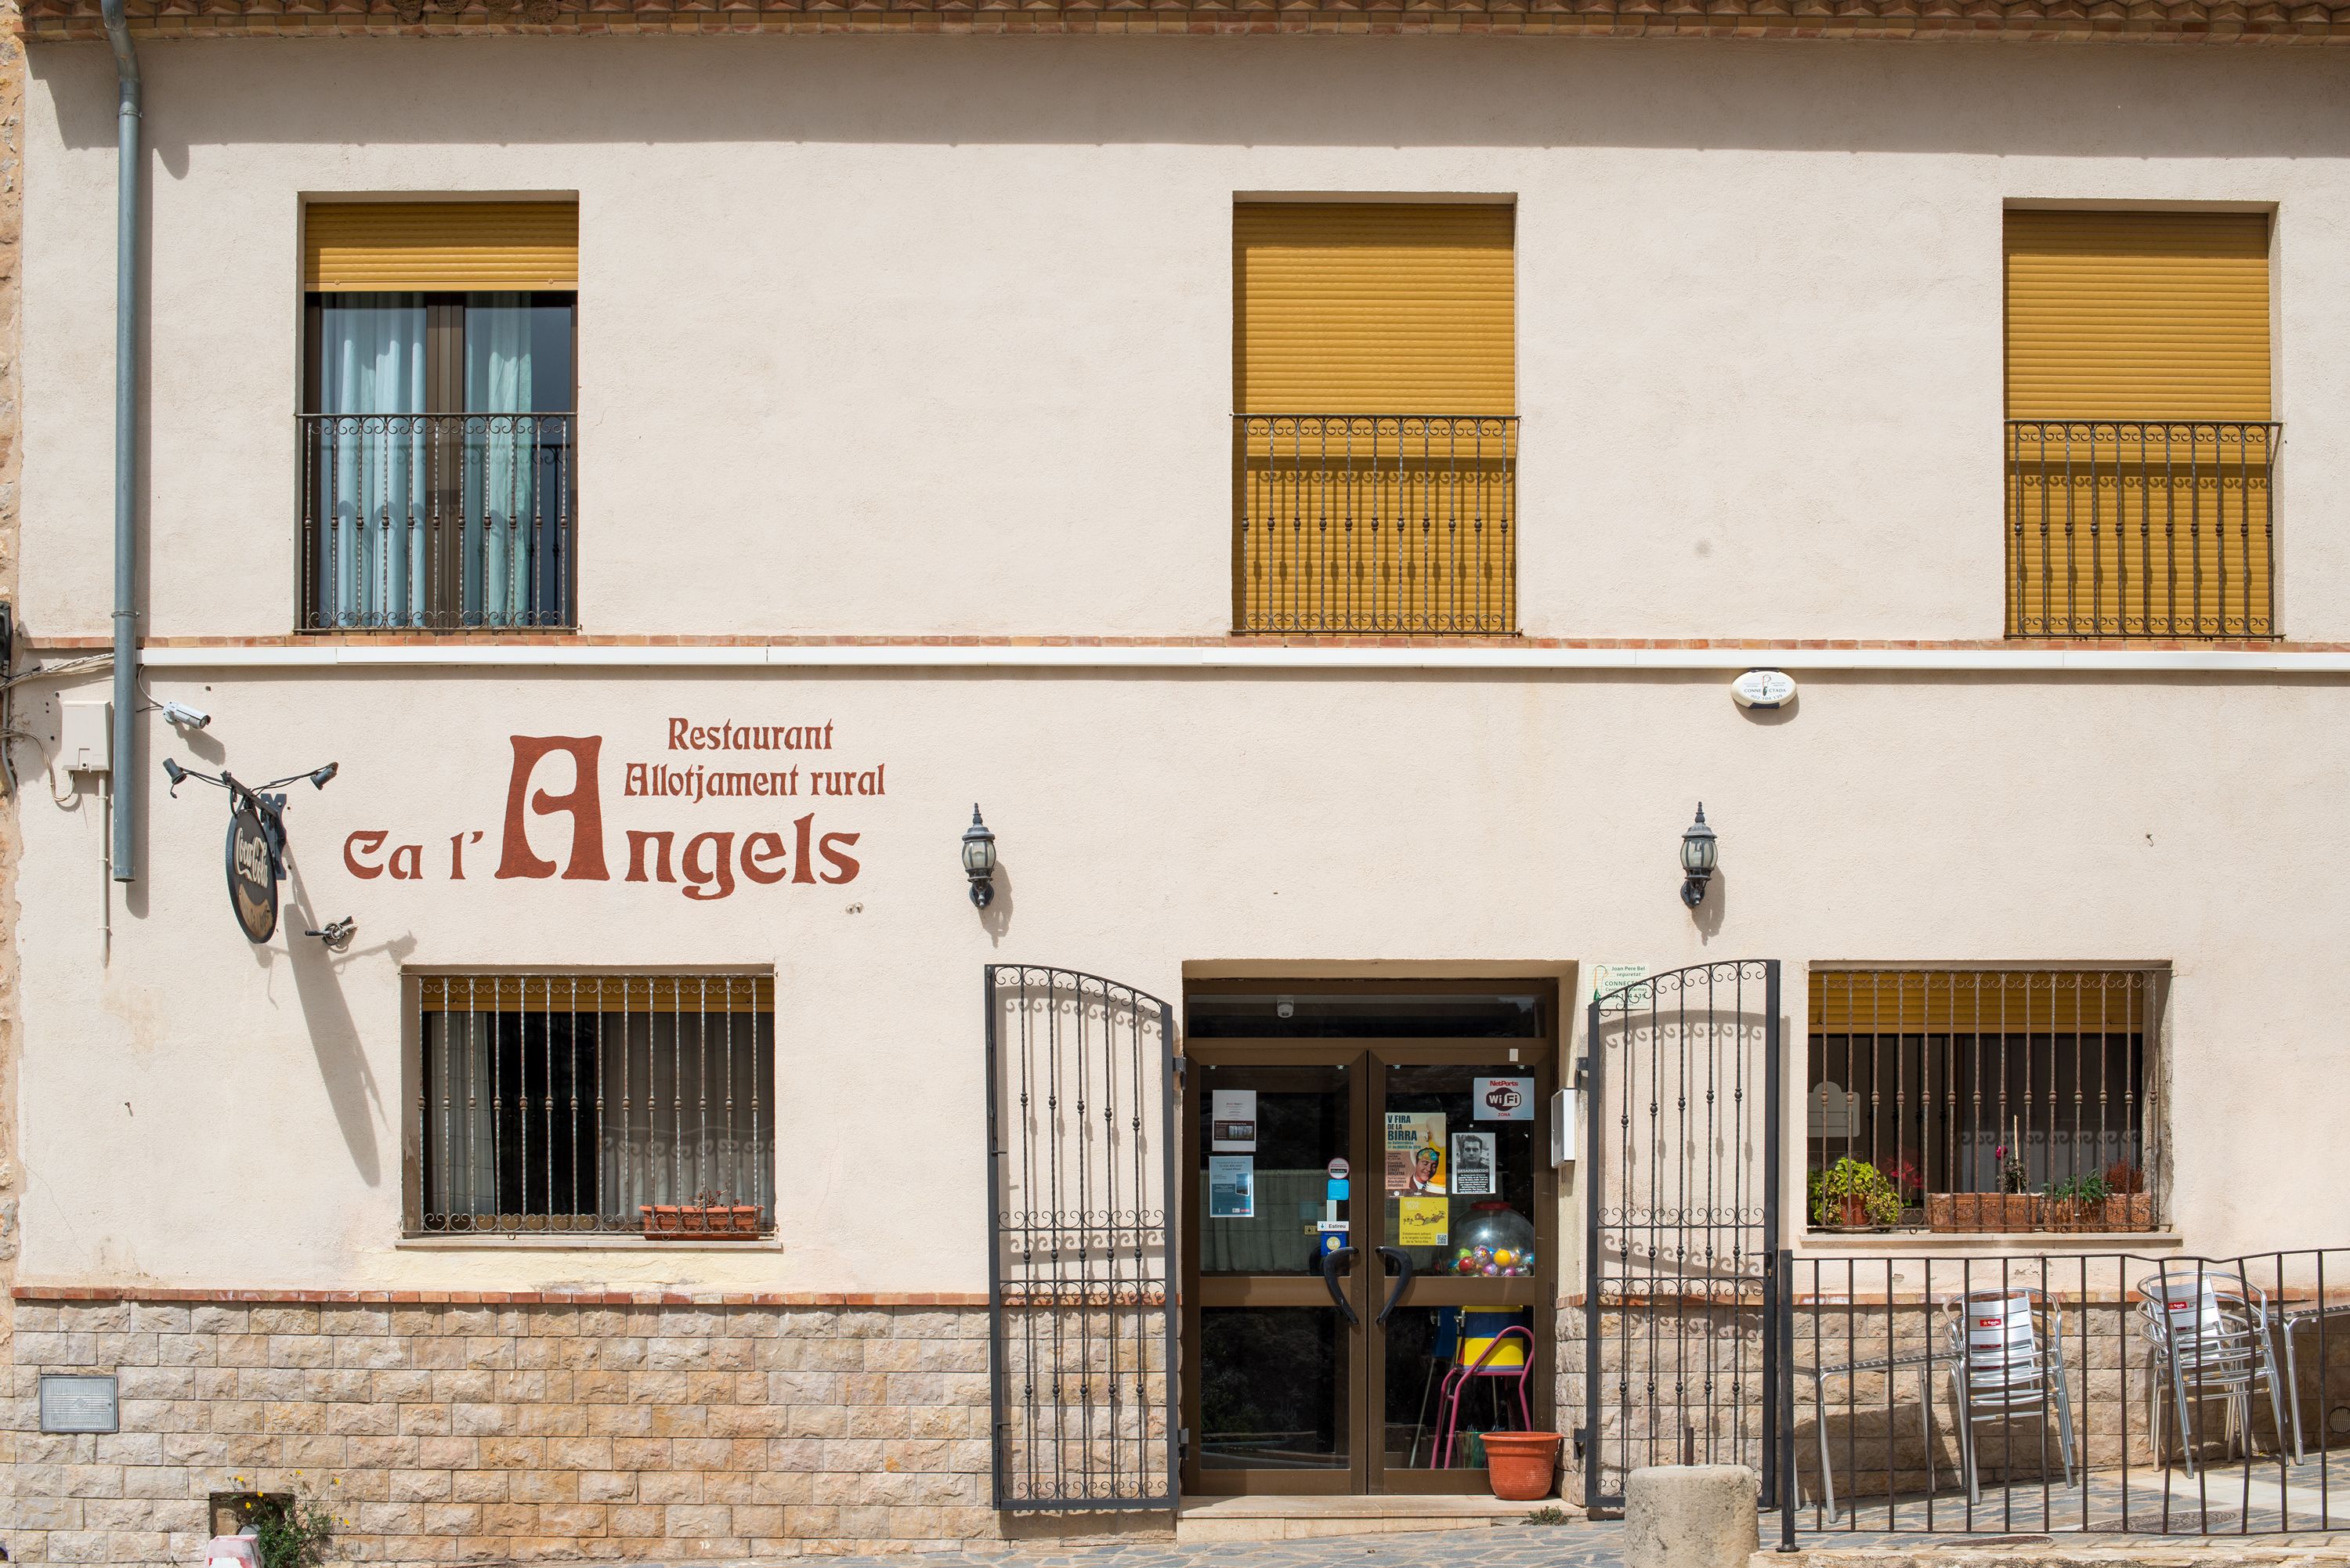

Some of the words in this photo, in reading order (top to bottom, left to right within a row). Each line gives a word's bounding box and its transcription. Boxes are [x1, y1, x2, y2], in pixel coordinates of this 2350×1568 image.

[668, 717, 833, 750] Restaurant
[624, 762, 799, 804] Allotjament
[810, 763, 885, 796] rural
[343, 830, 423, 880] Ca
[494, 735, 861, 901] Angels
[1387, 1130, 1417, 1141] BIRRA
